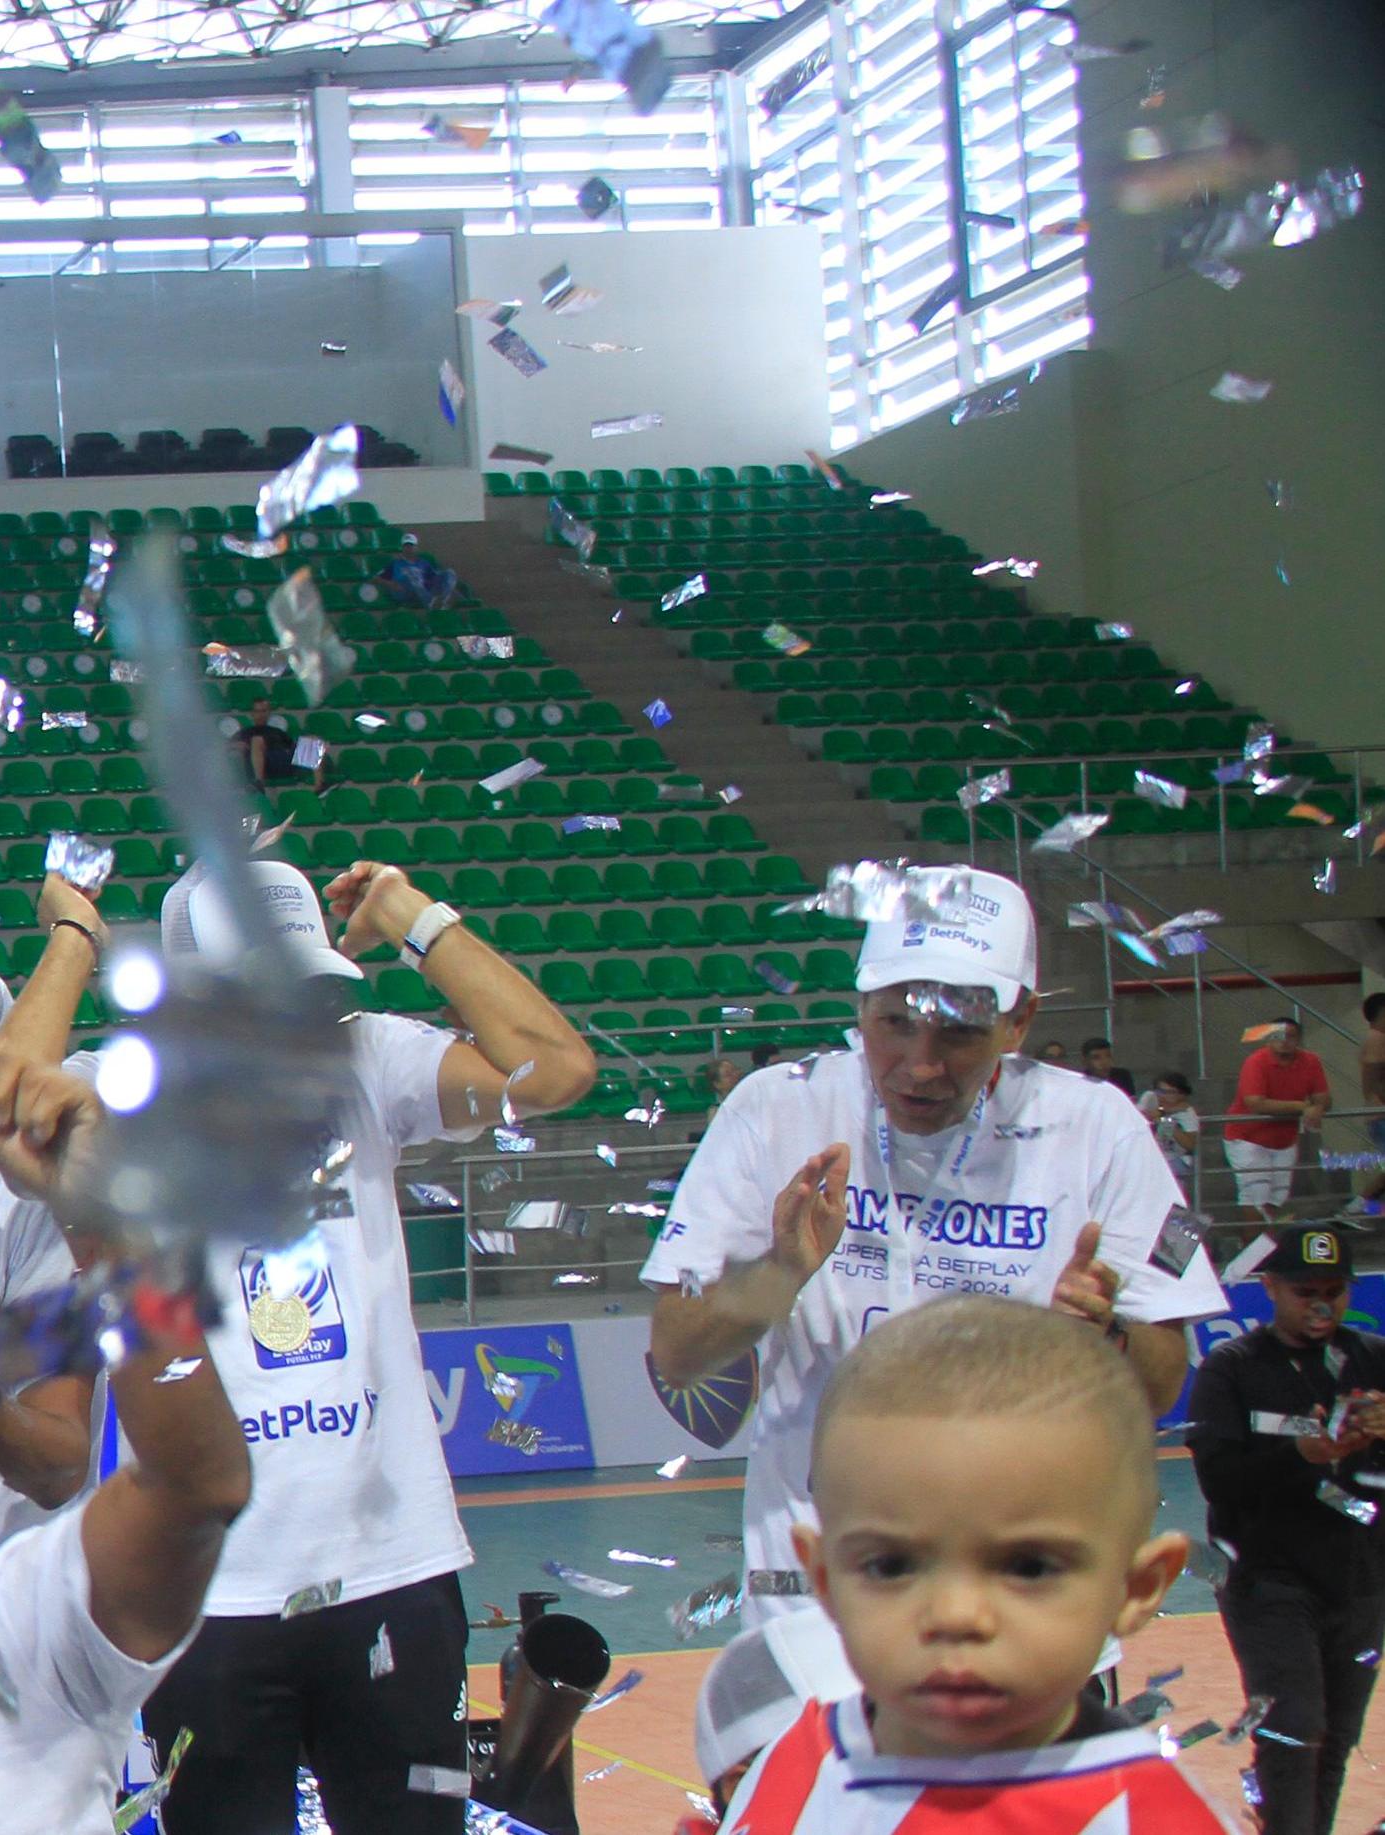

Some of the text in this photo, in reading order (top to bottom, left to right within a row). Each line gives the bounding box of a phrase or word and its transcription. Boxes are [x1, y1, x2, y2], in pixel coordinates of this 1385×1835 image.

[929, 927, 980, 948] BetPlay
[937, 1256, 1032, 1278] BETPLAY
[914, 1274, 955, 1290] FCF
[961, 1279, 1010, 1297] 2024
[241, 1399, 359, 1443] etPlay
